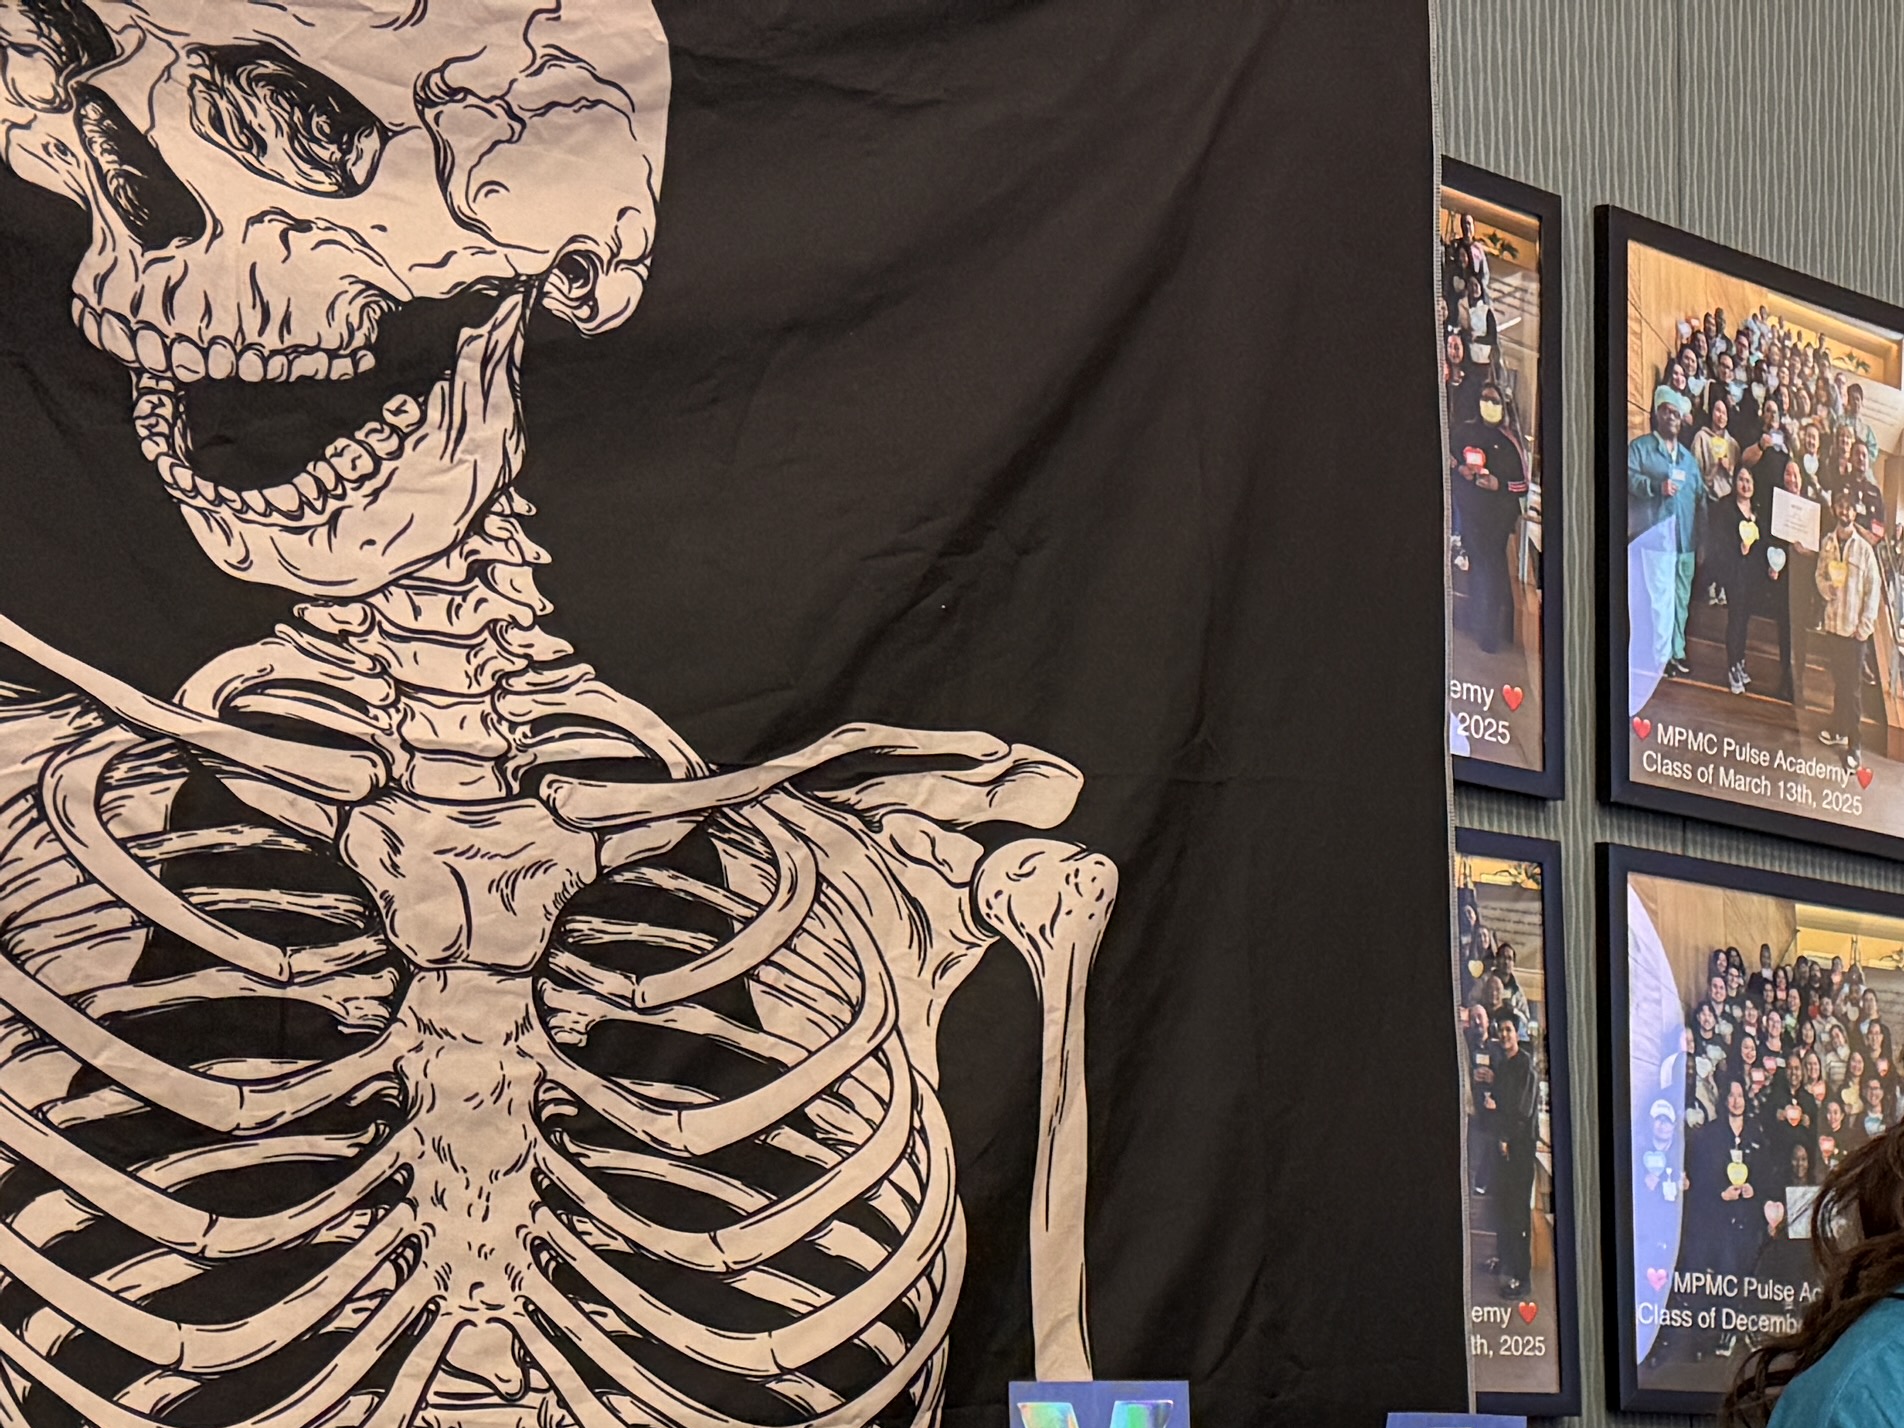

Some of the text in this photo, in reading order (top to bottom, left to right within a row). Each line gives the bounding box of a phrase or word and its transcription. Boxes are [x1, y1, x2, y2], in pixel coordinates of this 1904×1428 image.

[1642, 750, 1863, 816] Class of March 13th, 2025
[1657, 723, 1851, 788] MPMC Pulse Academy
